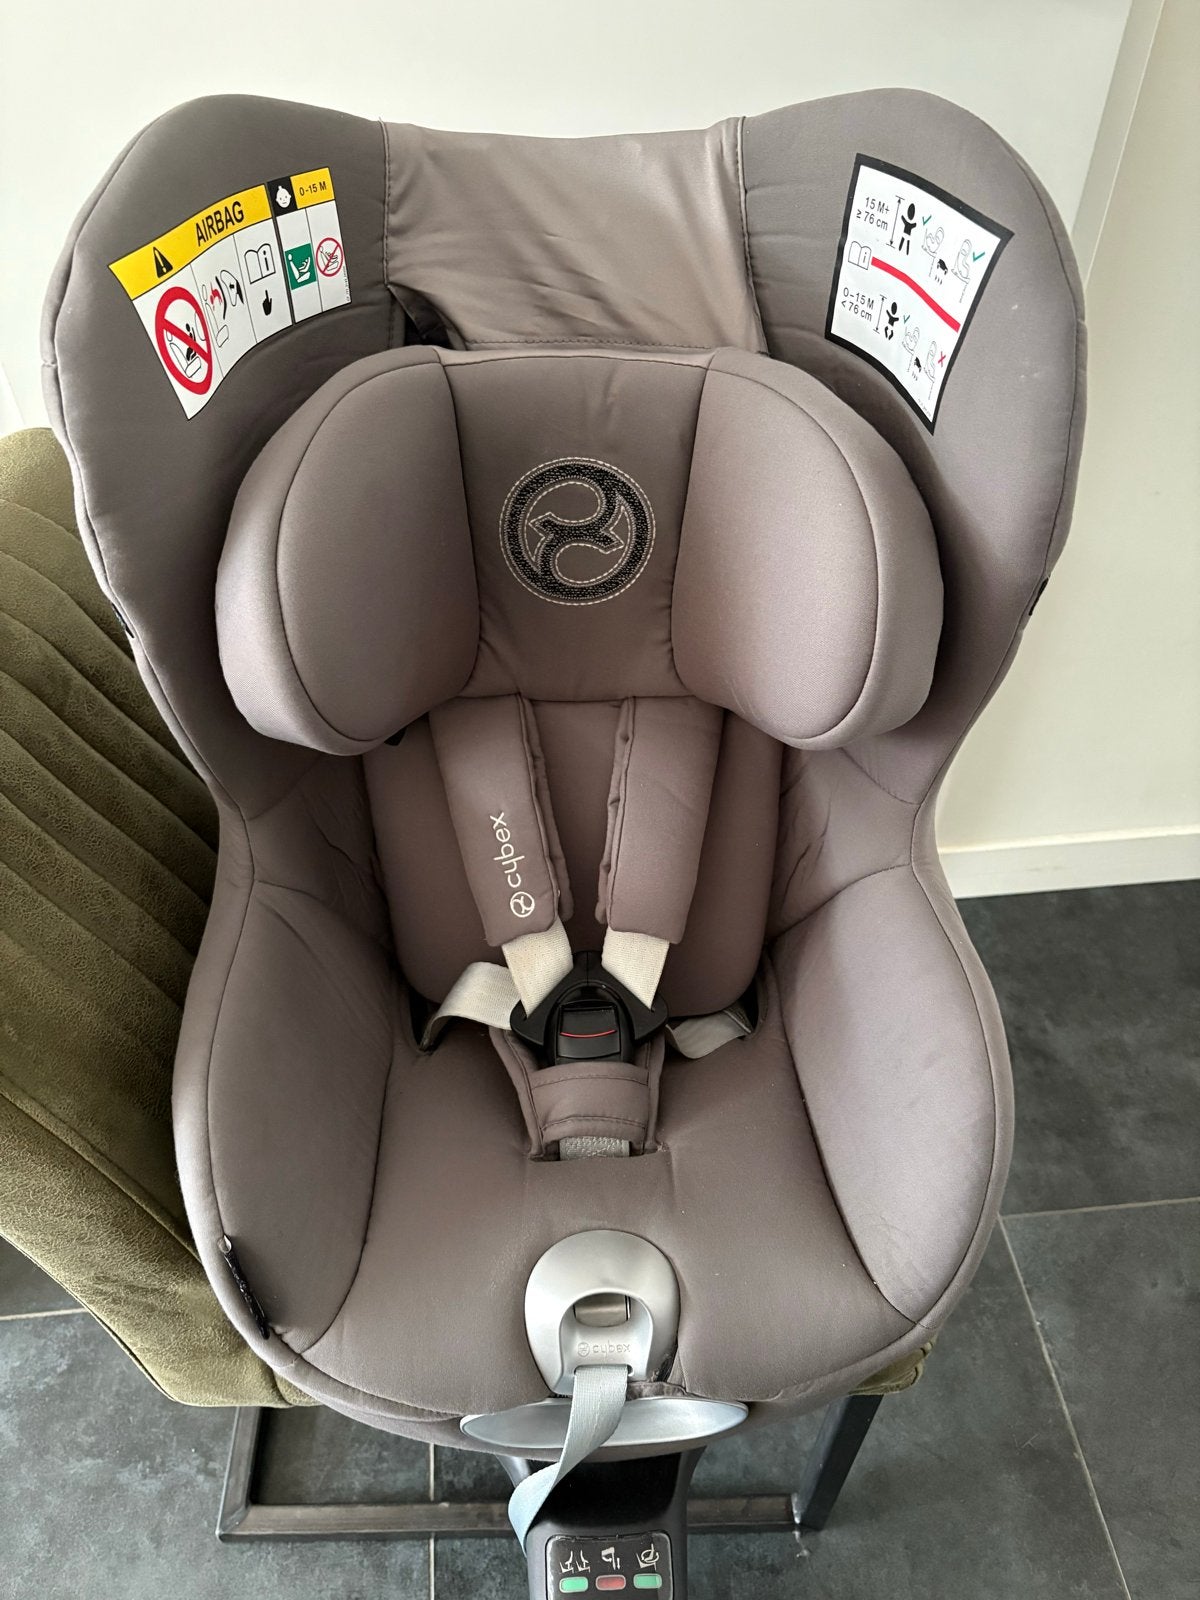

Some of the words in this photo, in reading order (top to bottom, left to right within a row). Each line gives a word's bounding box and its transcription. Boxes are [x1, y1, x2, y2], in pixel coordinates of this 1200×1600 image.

[319, 181, 327, 191] M
[865, 196, 876, 210] 15
[877, 200, 890, 214] M+
[195, 200, 245, 247] AIRBAG
[876, 218, 889, 231] cm
[866, 297, 874, 310] M
[860, 309, 873, 322] cm
[490, 811, 525, 888] cybex
[592, 1339, 632, 1359] cybex
